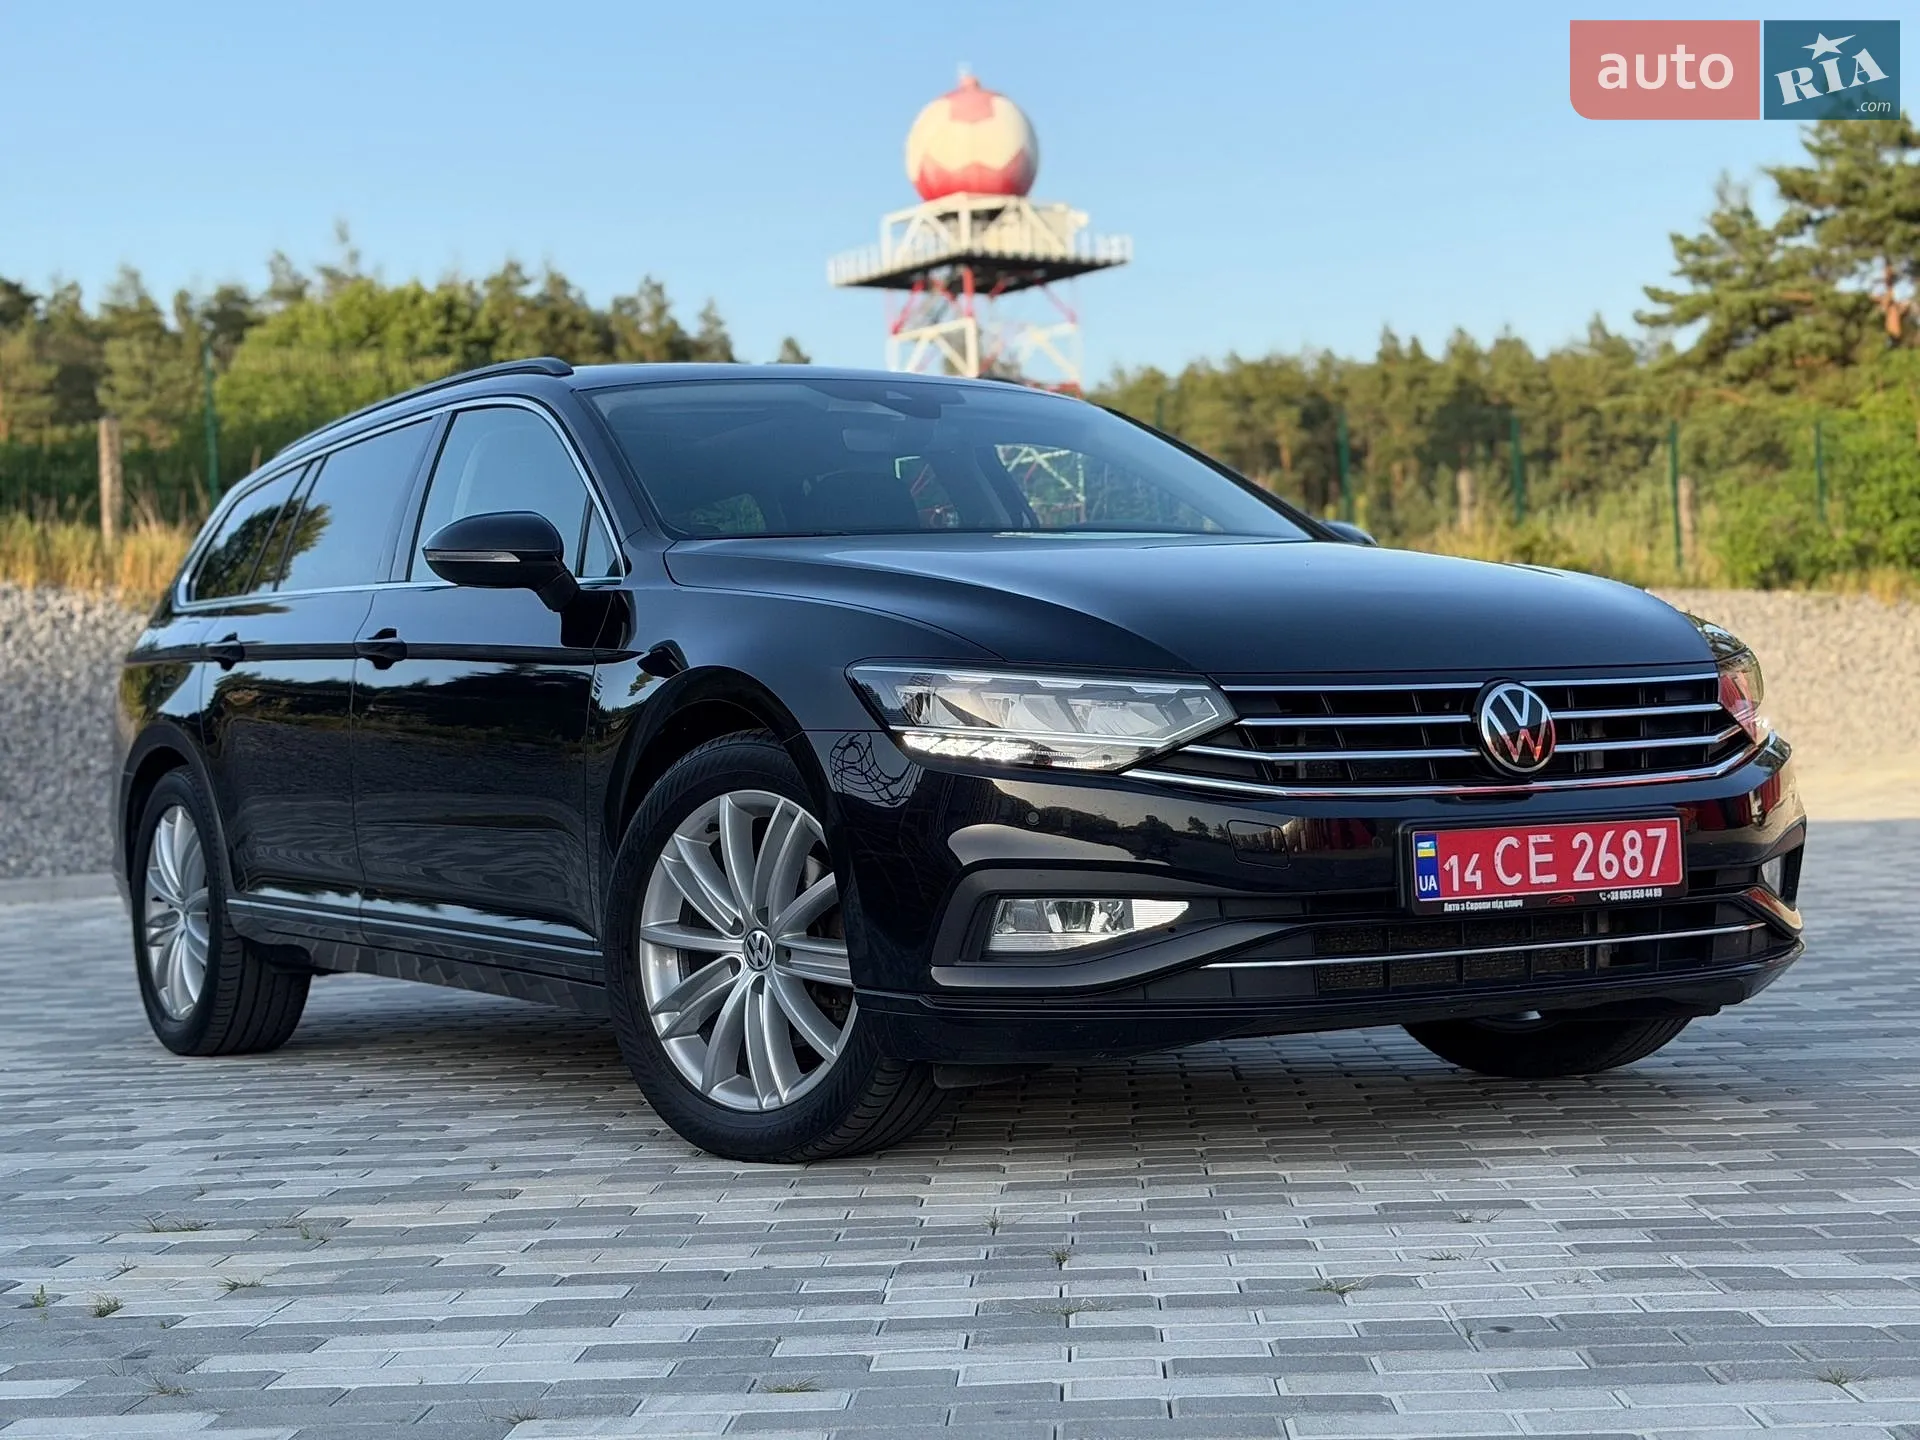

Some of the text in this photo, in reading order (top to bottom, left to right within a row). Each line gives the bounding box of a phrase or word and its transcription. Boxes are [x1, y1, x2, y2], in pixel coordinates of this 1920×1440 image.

[1443, 828, 1667, 891] 14 CE 2687
[1419, 875, 1438, 891] UA
